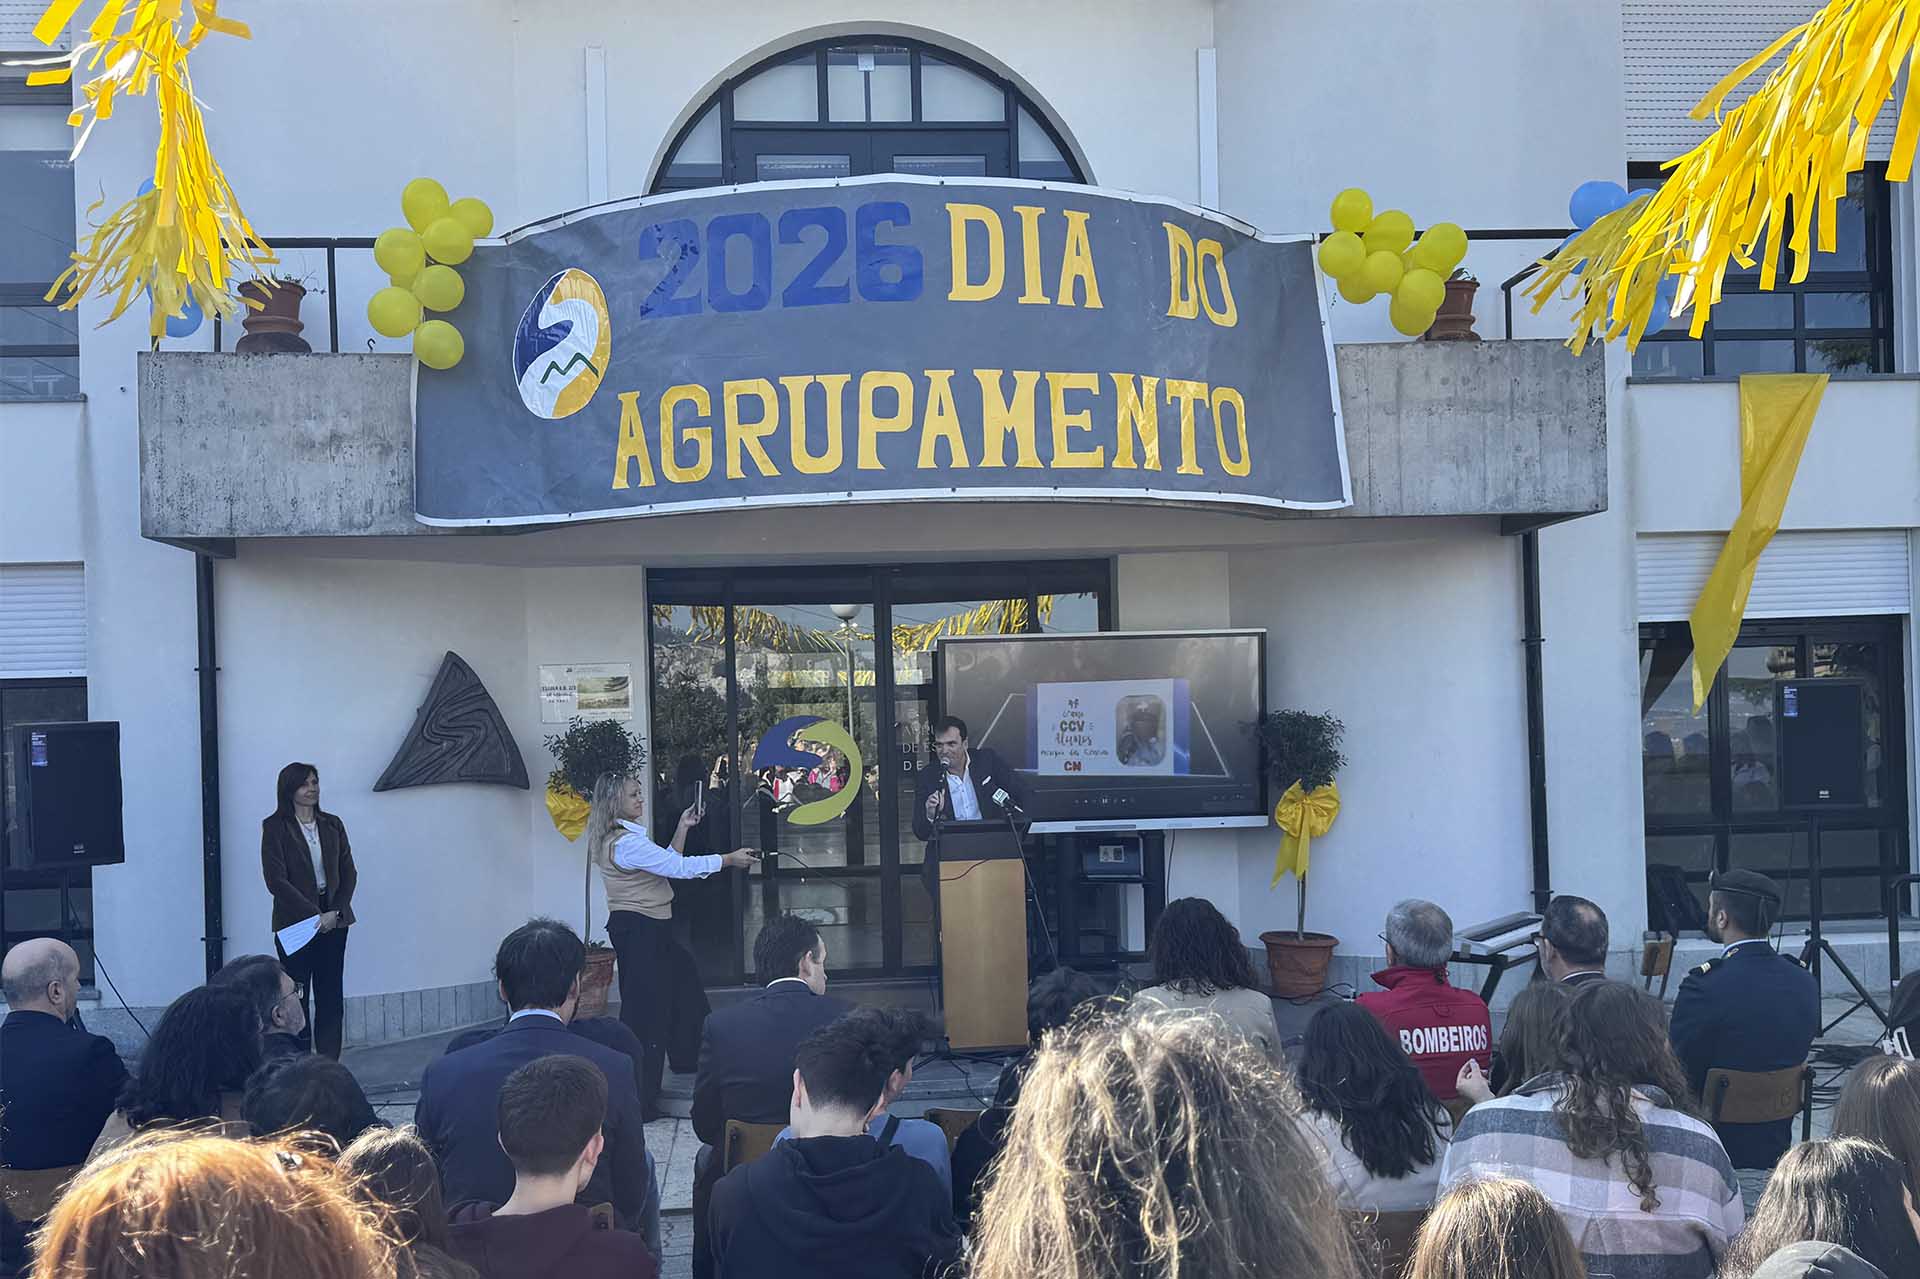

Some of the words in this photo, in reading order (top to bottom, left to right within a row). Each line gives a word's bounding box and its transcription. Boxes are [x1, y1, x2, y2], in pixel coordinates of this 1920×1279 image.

[638, 200, 924, 320] 2026
[946, 202, 1104, 309] DIA
[1162, 221, 1239, 328] DO
[611, 369, 1252, 489] AGRUPAMENTO
[1059, 720, 1085, 732] CCV
[1399, 1024, 1488, 1055] BOMBEIROS
